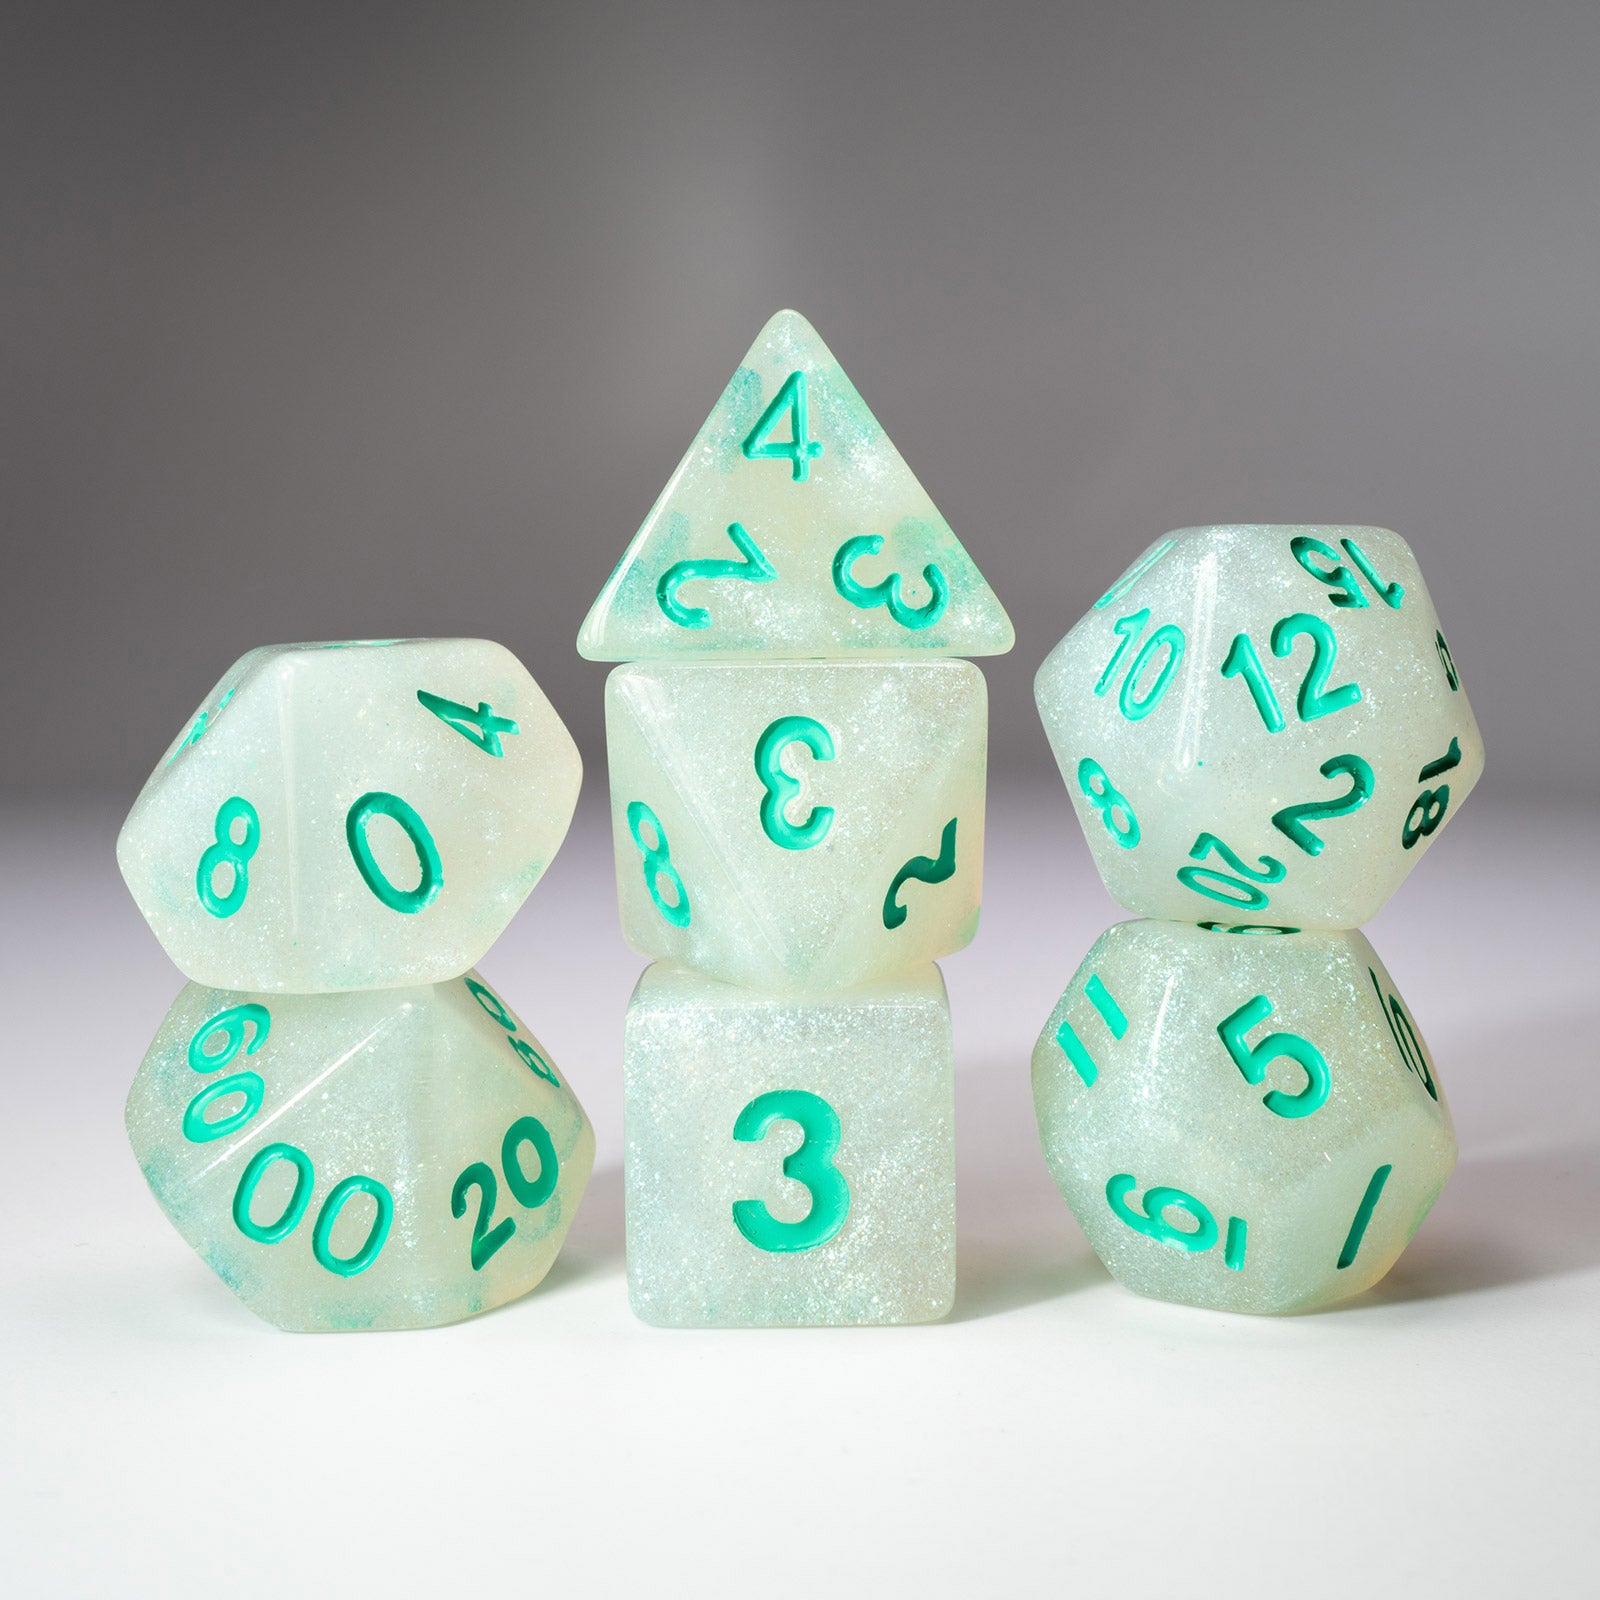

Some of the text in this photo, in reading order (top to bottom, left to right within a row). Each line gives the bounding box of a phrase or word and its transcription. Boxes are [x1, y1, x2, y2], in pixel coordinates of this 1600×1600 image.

[738, 370, 825, 482] 4
[655, 522, 778, 630] 2
[831, 534, 950, 631] 3
[1290, 536, 1405, 609] 15
[1093, 608, 1185, 721] 10
[1220, 612, 1362, 733] 12
[417, 689, 519, 758] 4
[754, 715, 835, 851] 3
[1077, 757, 1141, 850] 8
[1272, 753, 1375, 857] 2
[1402, 736, 1461, 849] 18
[196, 796, 261, 919] 8
[345, 791, 444, 915] 0
[626, 801, 691, 929] 8
[882, 817, 958, 930] 2
[1176, 832, 1287, 911] 20
[1056, 973, 1129, 1088] 11
[1217, 994, 1332, 1119] 5
[1368, 966, 1438, 1102] 10
[231, 1142, 395, 1278] 00
[450, 1115, 559, 1272] 20
[731, 1089, 851, 1254] 3
[1336, 1163, 1393, 1270] 1
